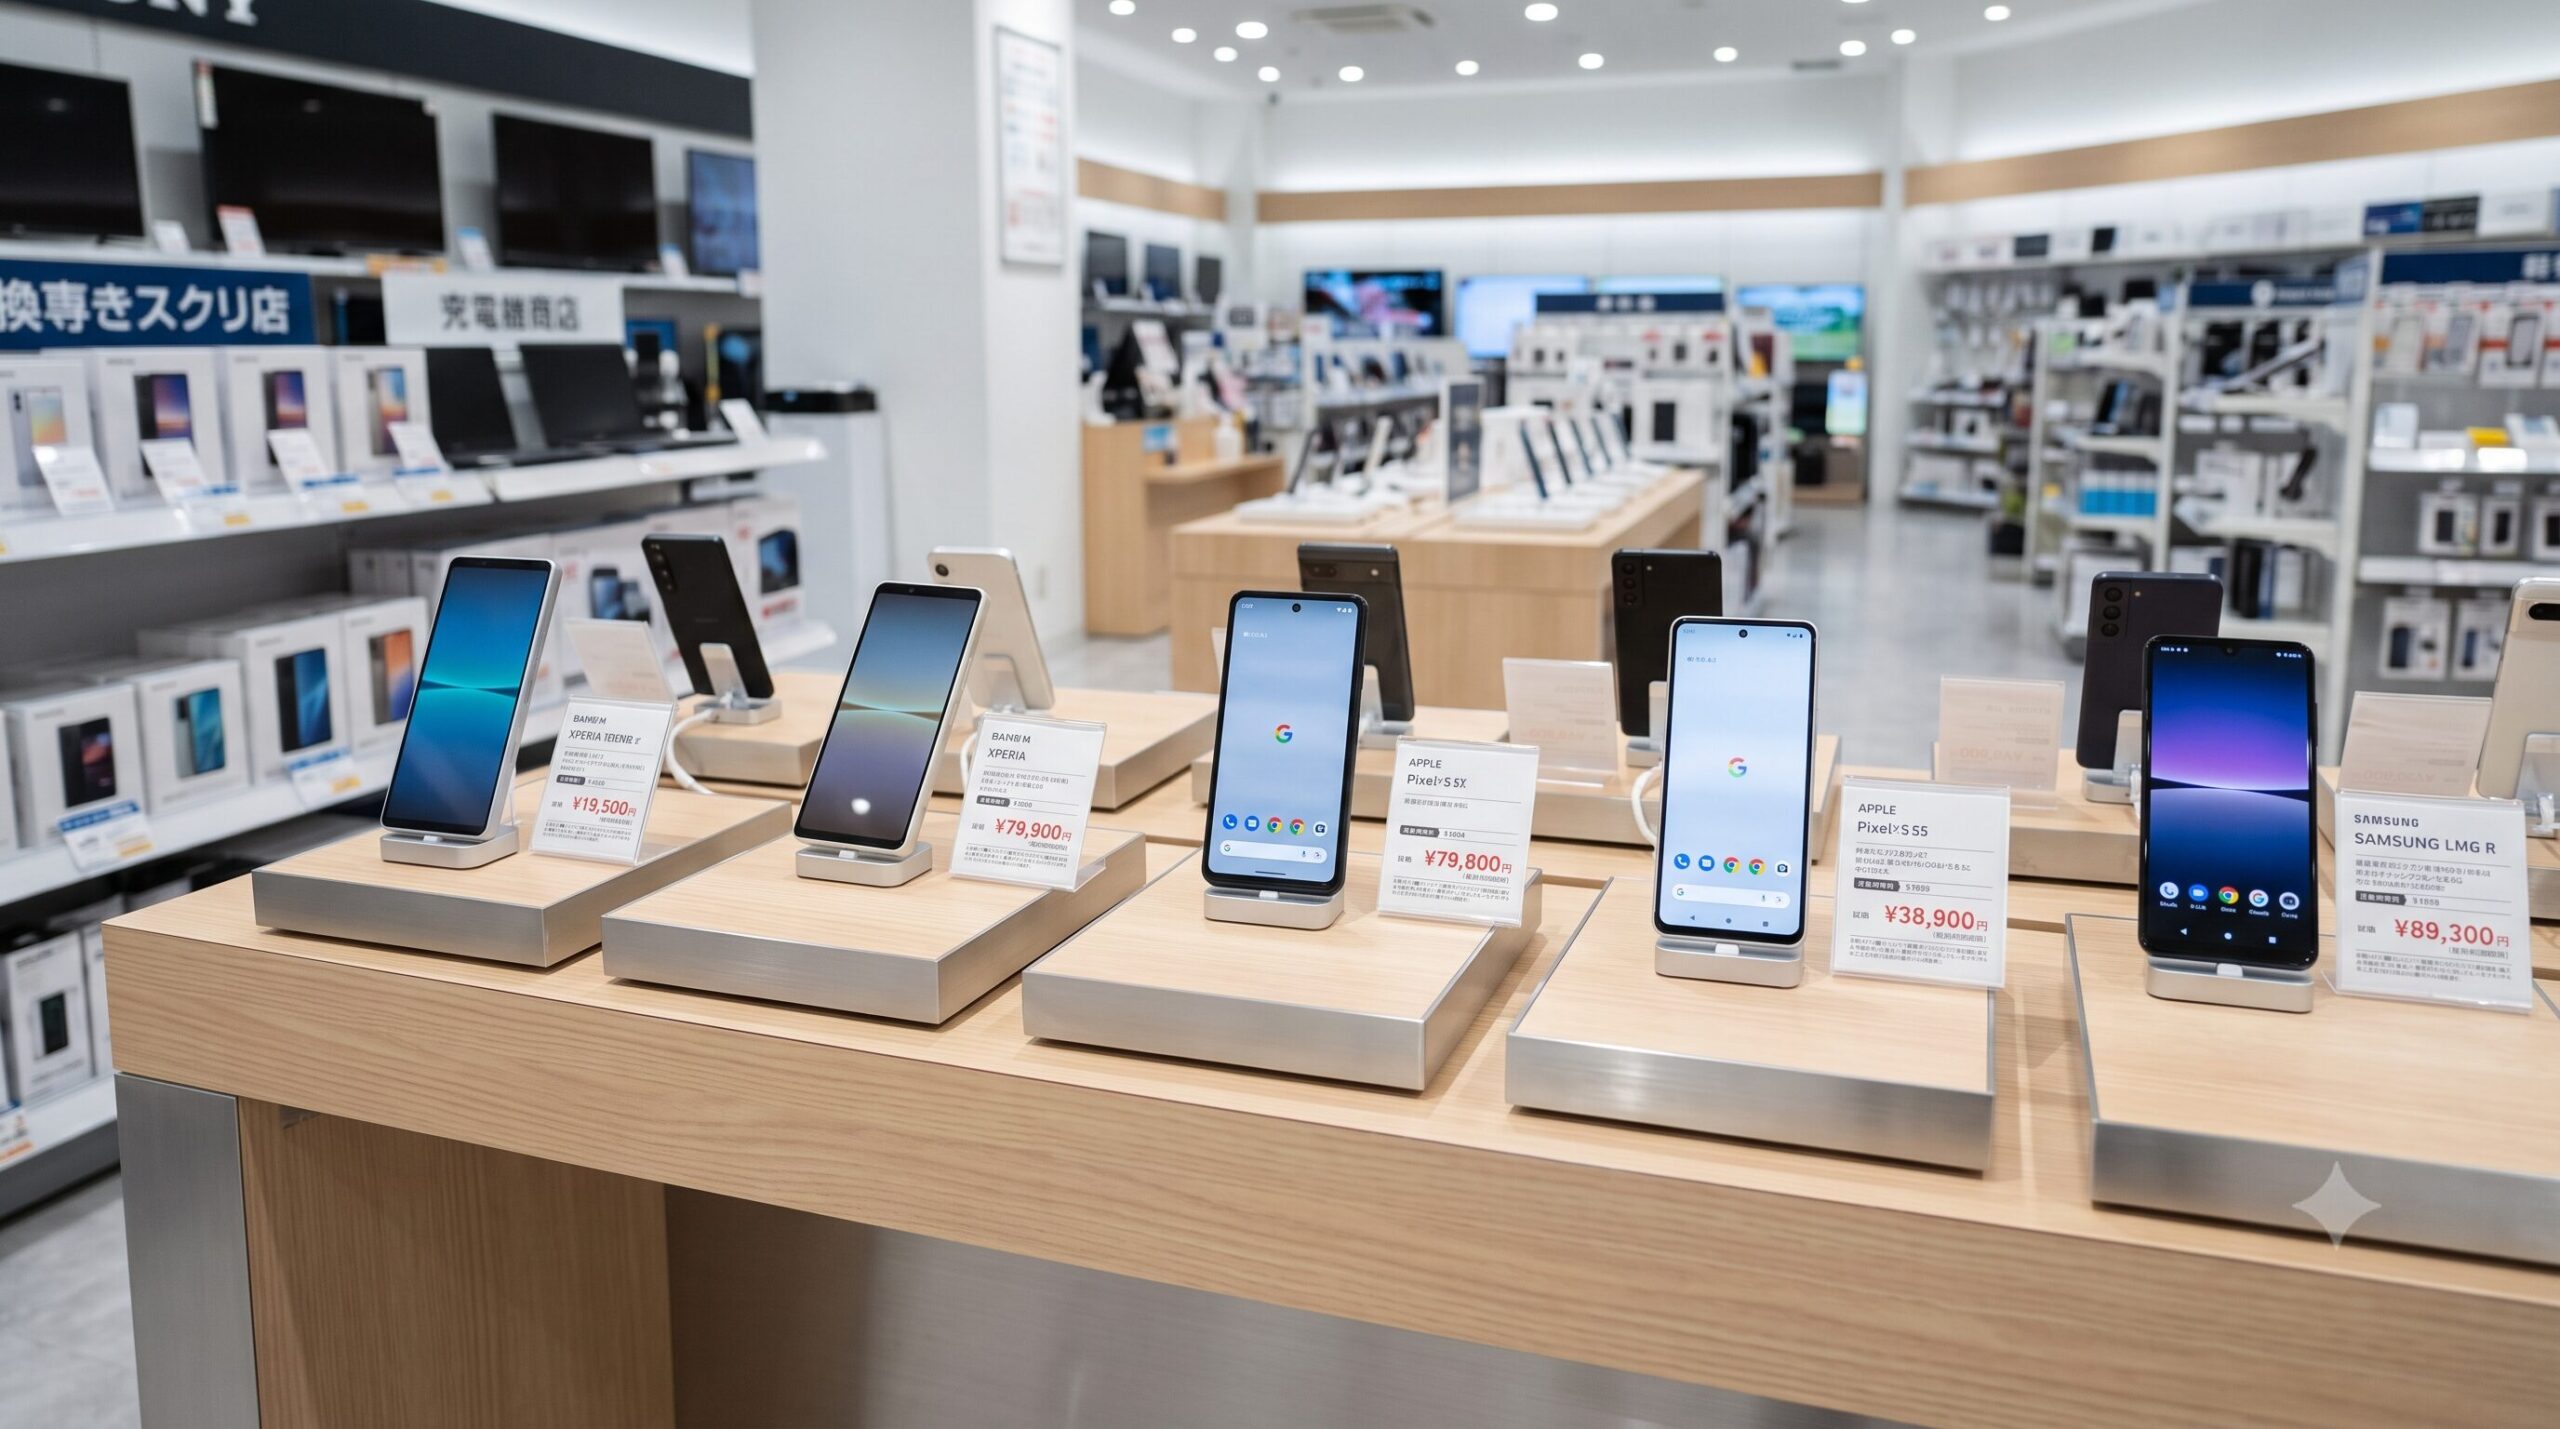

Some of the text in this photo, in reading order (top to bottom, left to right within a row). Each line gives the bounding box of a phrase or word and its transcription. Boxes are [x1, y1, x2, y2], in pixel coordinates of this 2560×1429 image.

[568, 730, 601, 741] XPERIA
[988, 748, 1026, 761] XPERIA
[1409, 758, 1442, 769] APPLE
[1858, 803, 1896, 815] APPLE
[2354, 814, 2419, 827] SAMSUNG
[2354, 832, 2496, 854] SAMSUNG LMG R
[1885, 905, 1988, 931] ¥38,900円
[2394, 919, 2509, 947] ¥89,300円
